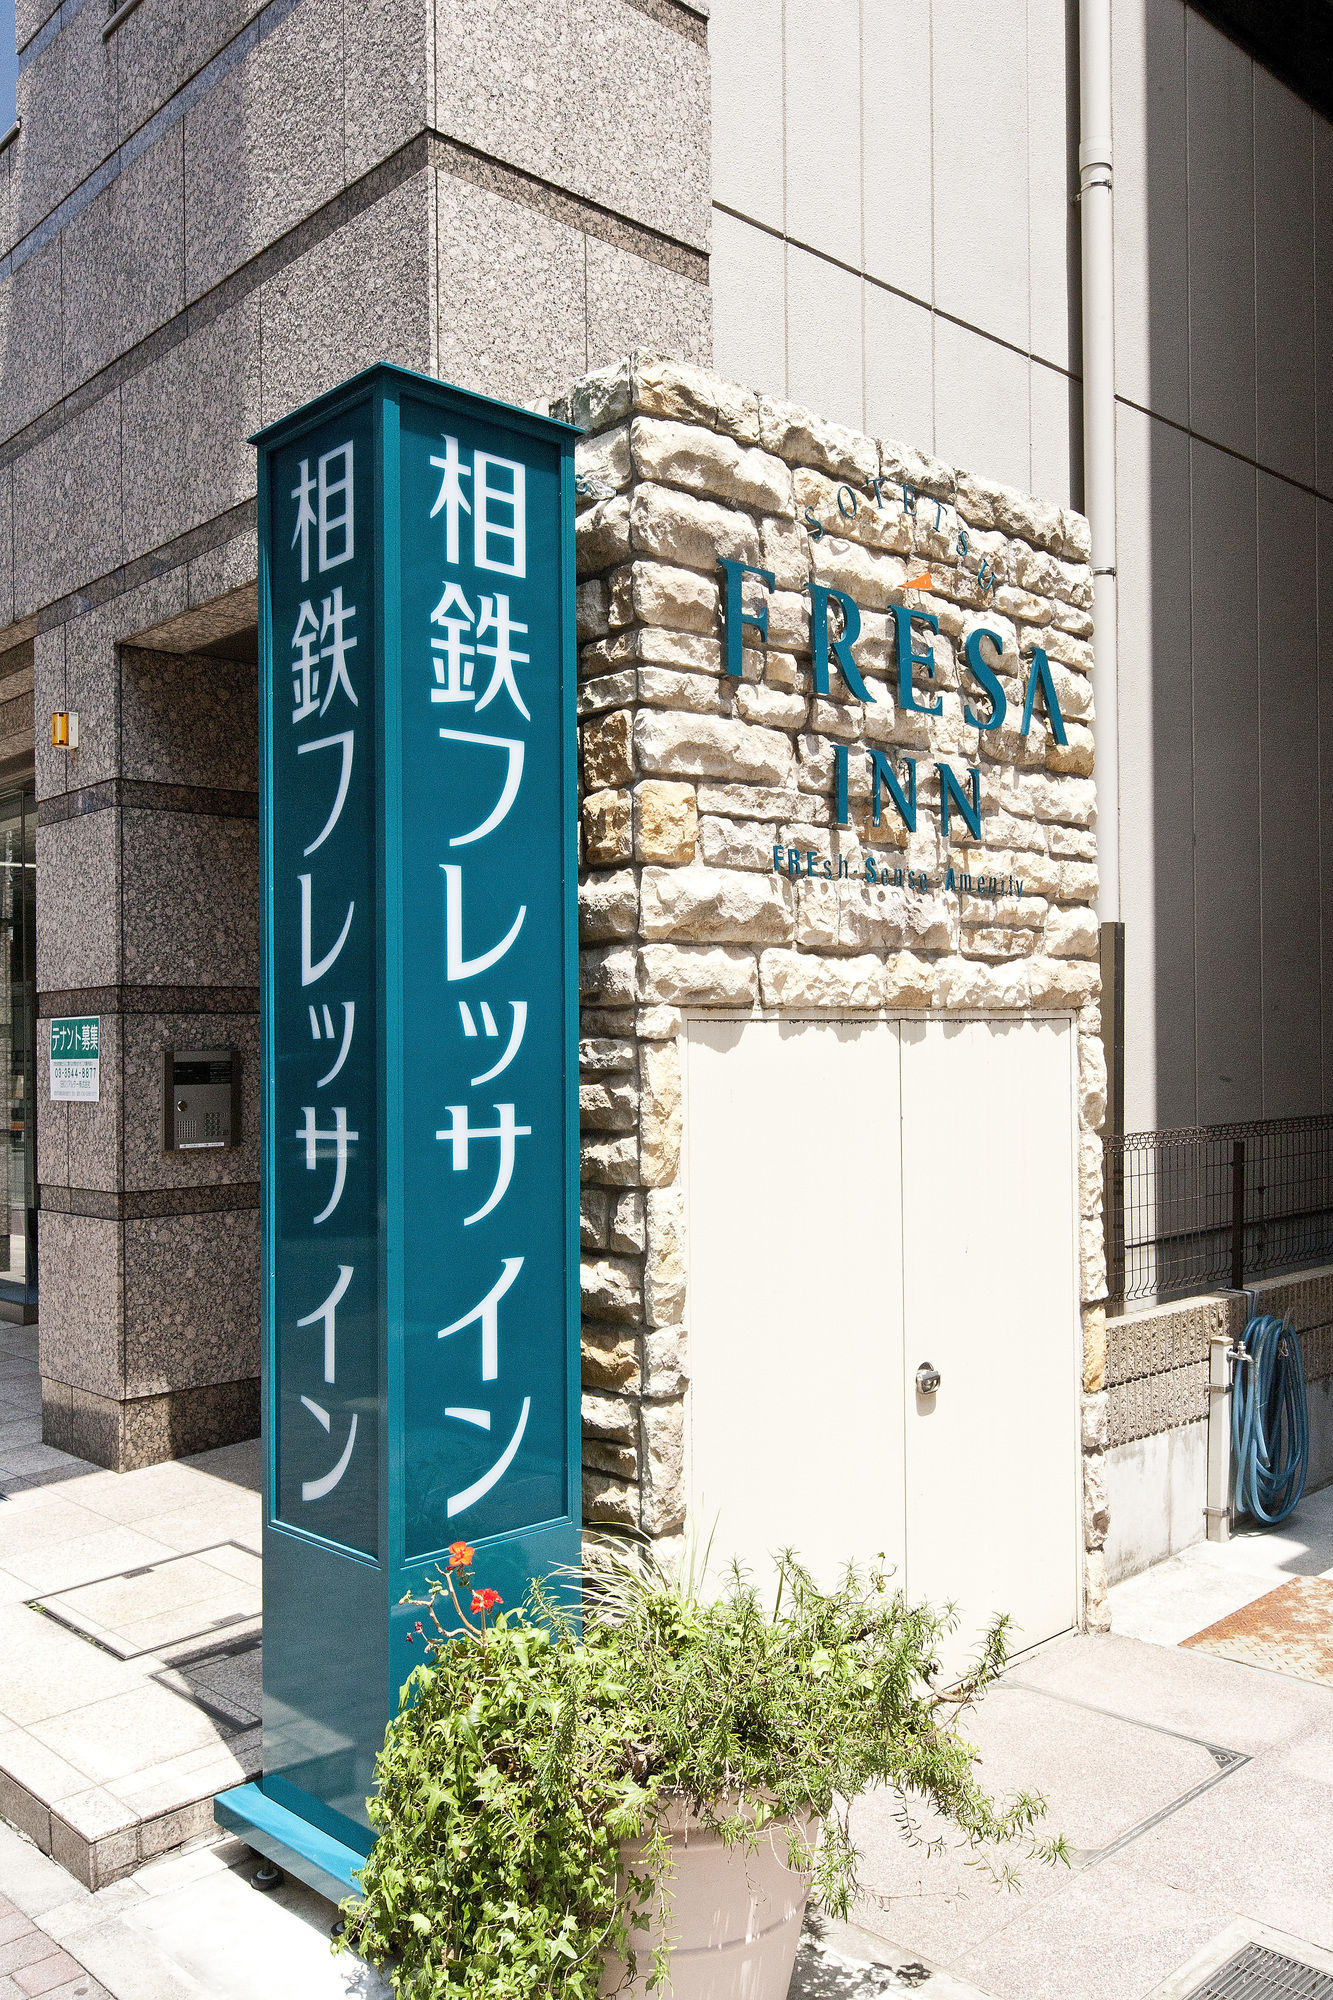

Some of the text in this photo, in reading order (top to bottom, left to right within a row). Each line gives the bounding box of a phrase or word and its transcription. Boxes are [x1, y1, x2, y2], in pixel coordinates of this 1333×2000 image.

[804, 476, 996, 591] SOTETSU
[716, 557, 1069, 746] FRESA
[830, 744, 981, 840] INN
[773, 844, 1024, 902] FREsh Sense Amenity
[291, 439, 359, 1501] 相鉄フレッサイン
[429, 433, 532, 1518] 相鉄フレッサイン
[51, 1024, 99, 1051] テナント募集
